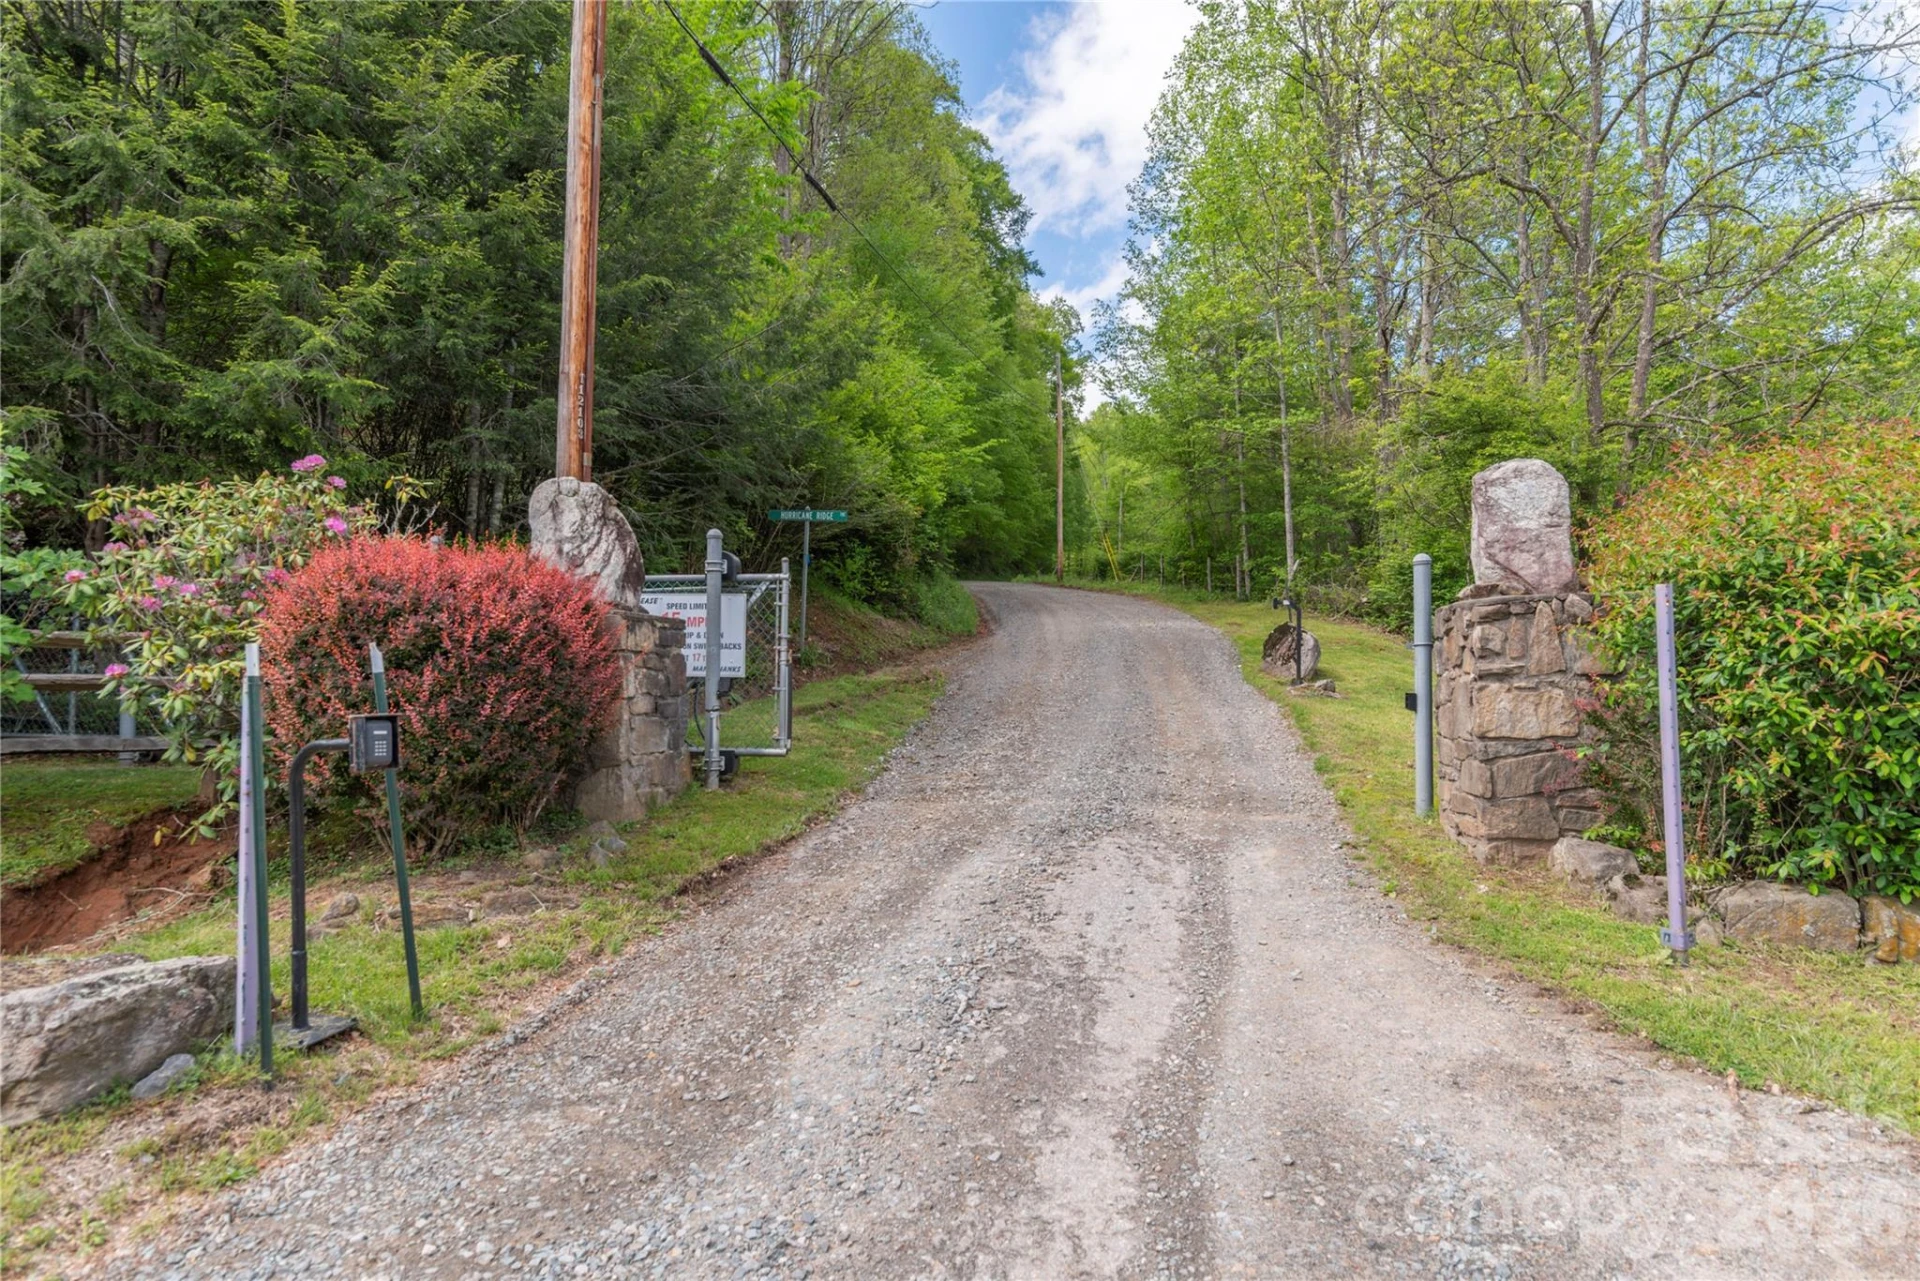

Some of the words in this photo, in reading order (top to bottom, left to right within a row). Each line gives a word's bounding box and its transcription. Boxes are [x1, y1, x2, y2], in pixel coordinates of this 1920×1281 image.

[781, 511, 813, 520] HURRICANE
[816, 511, 834, 520] RIDGE
[692, 654, 701, 662] 17
